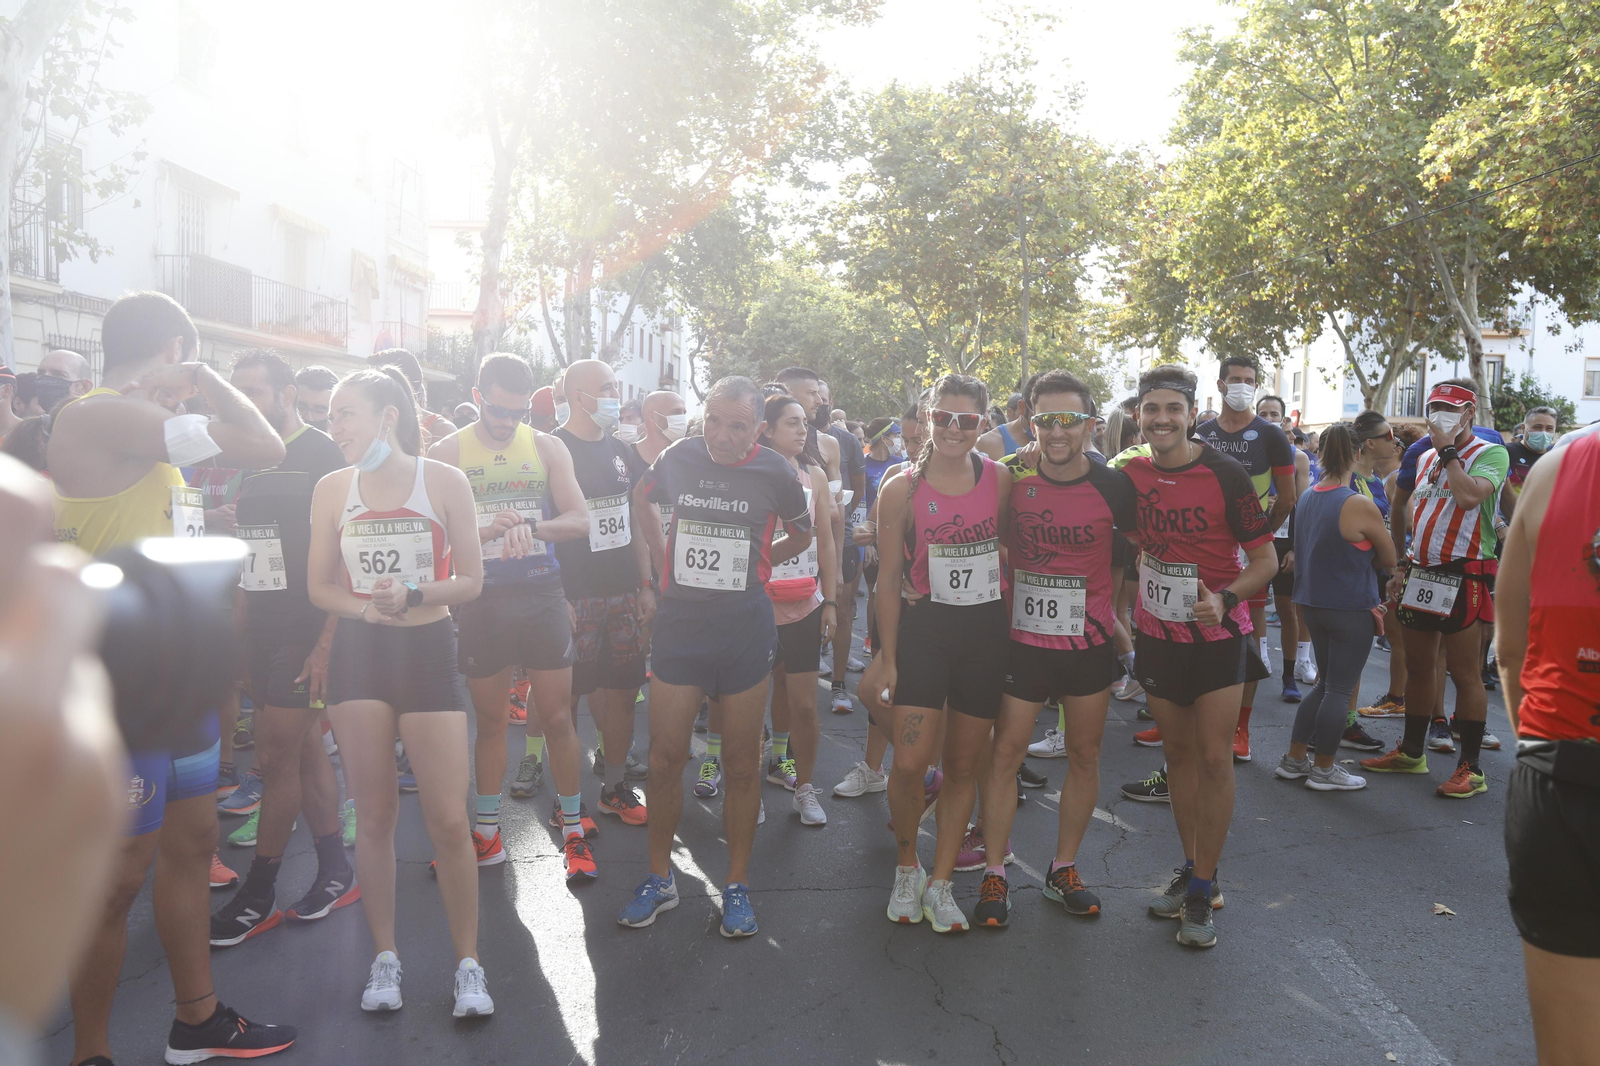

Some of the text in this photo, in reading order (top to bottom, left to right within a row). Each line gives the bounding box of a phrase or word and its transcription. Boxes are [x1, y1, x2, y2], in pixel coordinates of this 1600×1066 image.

[486, 480, 546, 493] RUNNER
[1434, 487, 1453, 499] Abue
[477, 505, 485, 513] 34
[486, 502, 508, 512] VUELTA
[515, 500, 537, 510] HUELVA
[596, 498, 616, 508] VUELTA
[616, 497, 621, 505] A
[678, 493, 749, 513] #Sevilla10
[347, 522, 424, 534] 34 VUELTA A HUELVA
[599, 516, 625, 536] 584
[1140, 505, 1209, 534] TIGRES
[246, 529, 252, 538] A
[251, 528, 275, 538] HUELVA
[682, 524, 745, 538] 34 VUELTA A HUELVA
[948, 517, 997, 544] TIGRES
[1029, 524, 1095, 545] TIGRES
[934, 542, 995, 556] 34 VUELTA A HUELVA
[359, 550, 402, 574] 562
[686, 548, 720, 572] 632
[950, 568, 973, 590] 87
[1162, 565, 1166, 574] A
[1167, 566, 1192, 576] HUELVA
[1420, 572, 1436, 580] VUELTA
[1440, 577, 1457, 586] HUELVA
[1018, 574, 1026, 582] 34
[1026, 575, 1048, 586] VUELTA
[1056, 579, 1080, 588] HUELVA
[1147, 580, 1172, 605] 617
[1416, 588, 1434, 604] 89
[1024, 596, 1058, 618] 618
[325, 880, 346, 898] N
[236, 908, 262, 928] N
